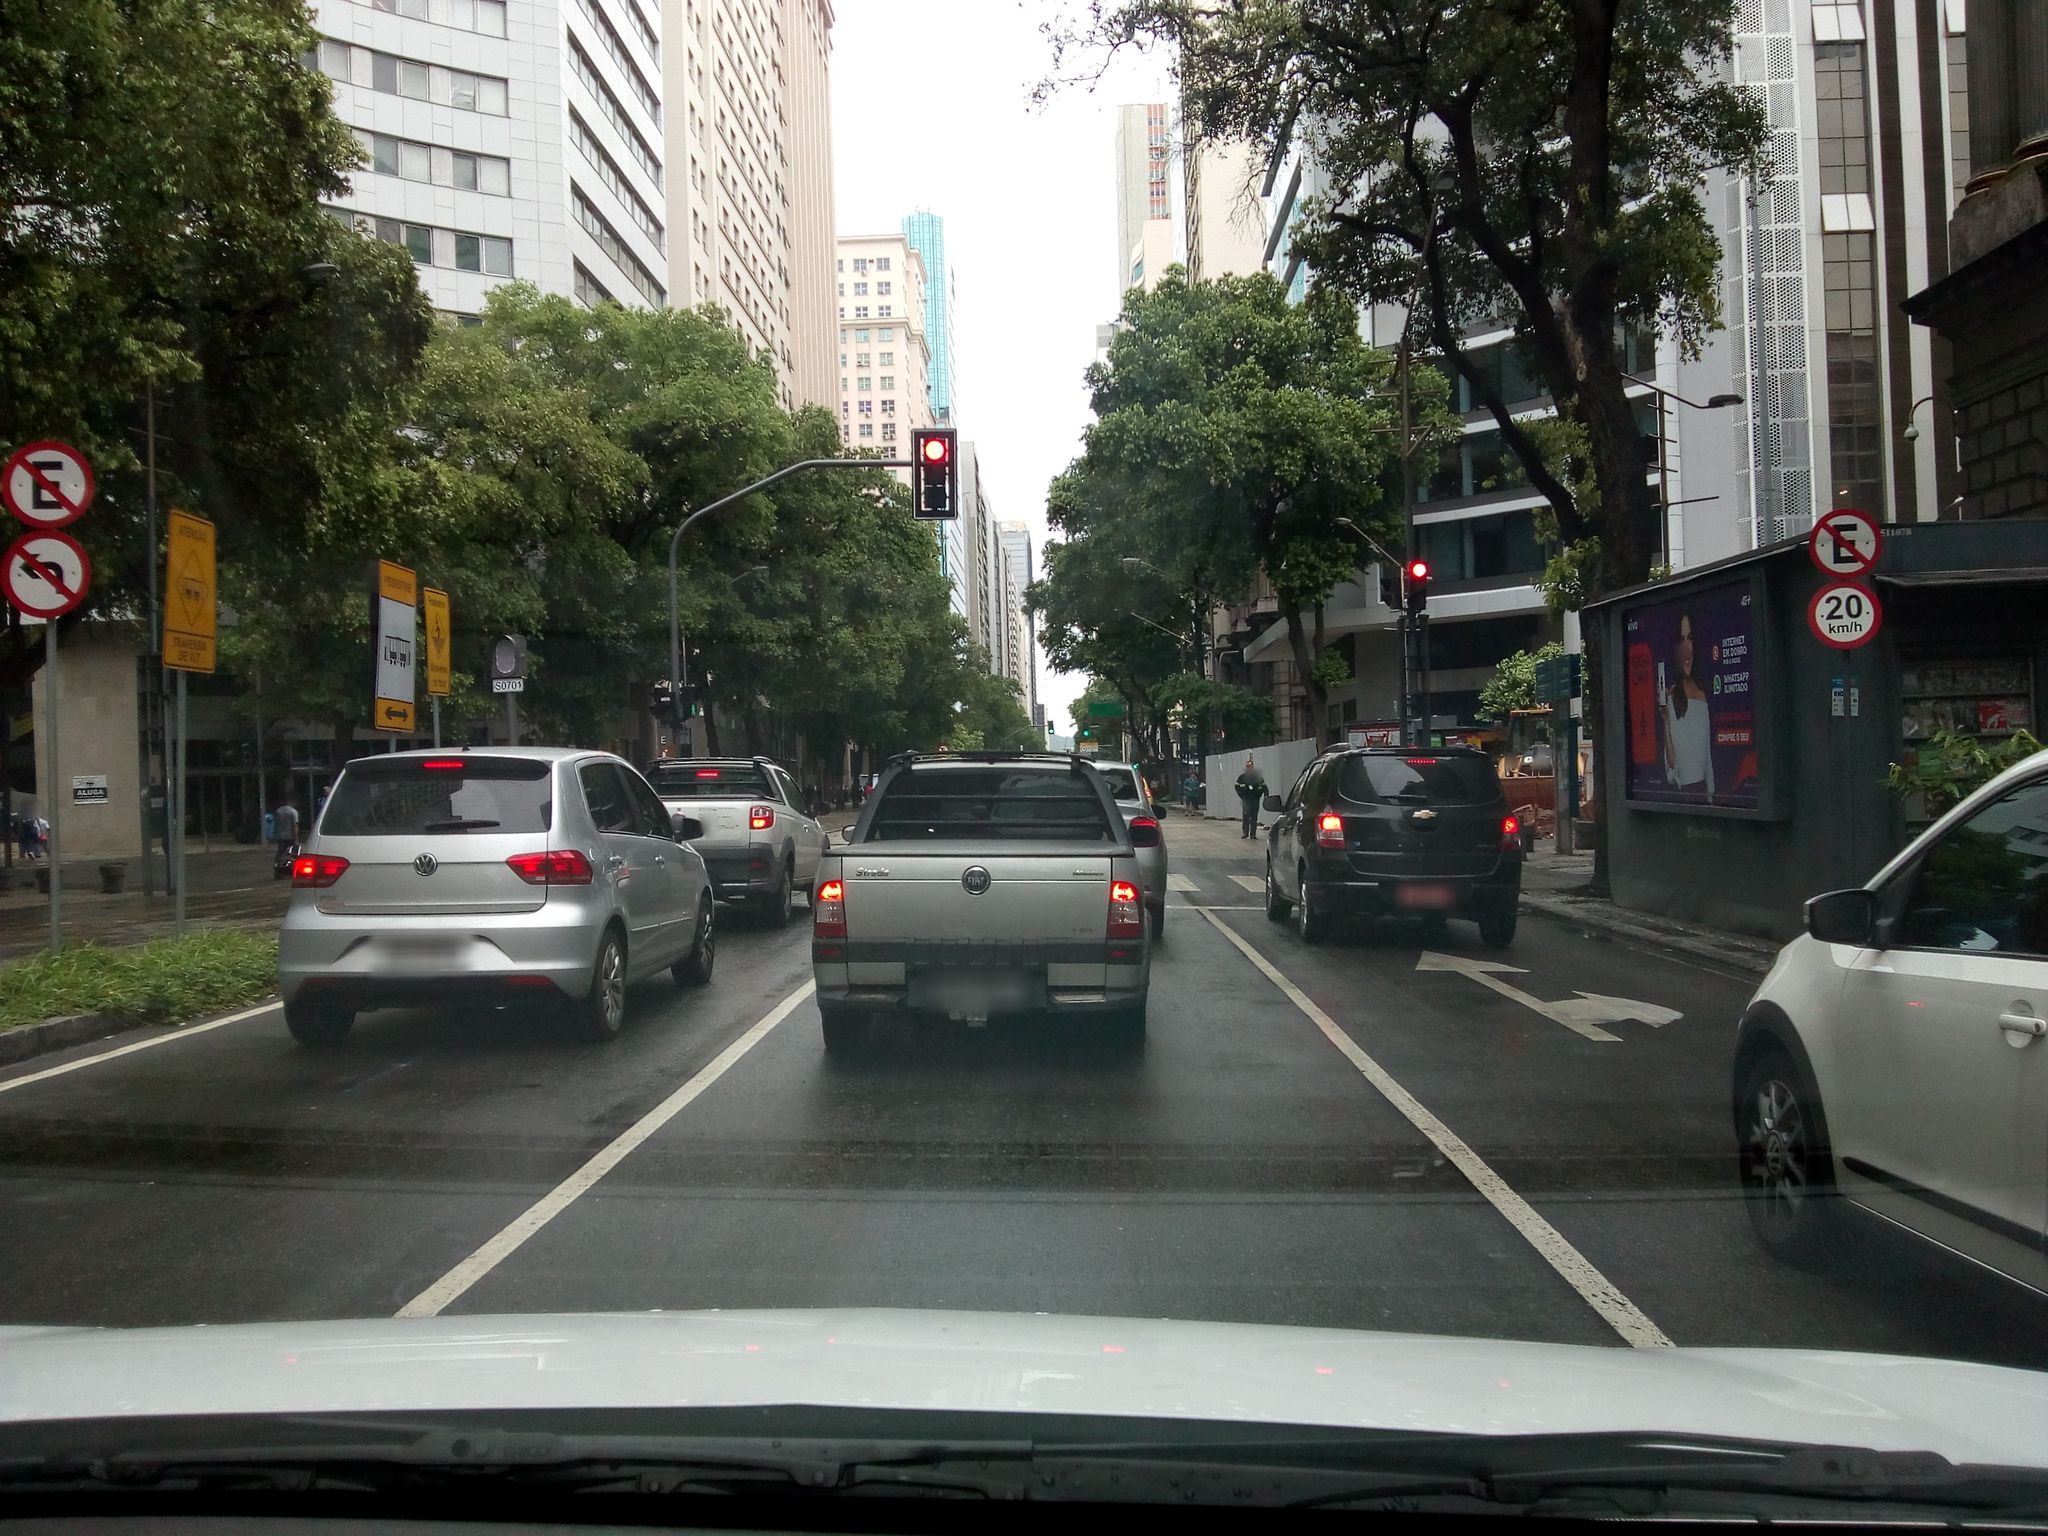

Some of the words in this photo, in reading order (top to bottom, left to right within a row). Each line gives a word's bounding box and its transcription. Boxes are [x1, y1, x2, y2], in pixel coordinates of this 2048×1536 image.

[32, 461, 63, 509] E
[1833, 524, 1858, 564] E
[1825, 594, 1862, 620] 20
[1627, 619, 1638, 631] vivo
[1829, 622, 1862, 634] km/h
[1723, 635, 1745, 647] INTERNET
[1724, 672, 1749, 683] WHATSAPP
[1724, 683, 1748, 694] ILIMITADO
[1717, 733, 1735, 742] COMPRE
[1740, 732, 1749, 741] SEU
[77, 788, 105, 796] ALUGA
[967, 876, 984, 886] FIAT
